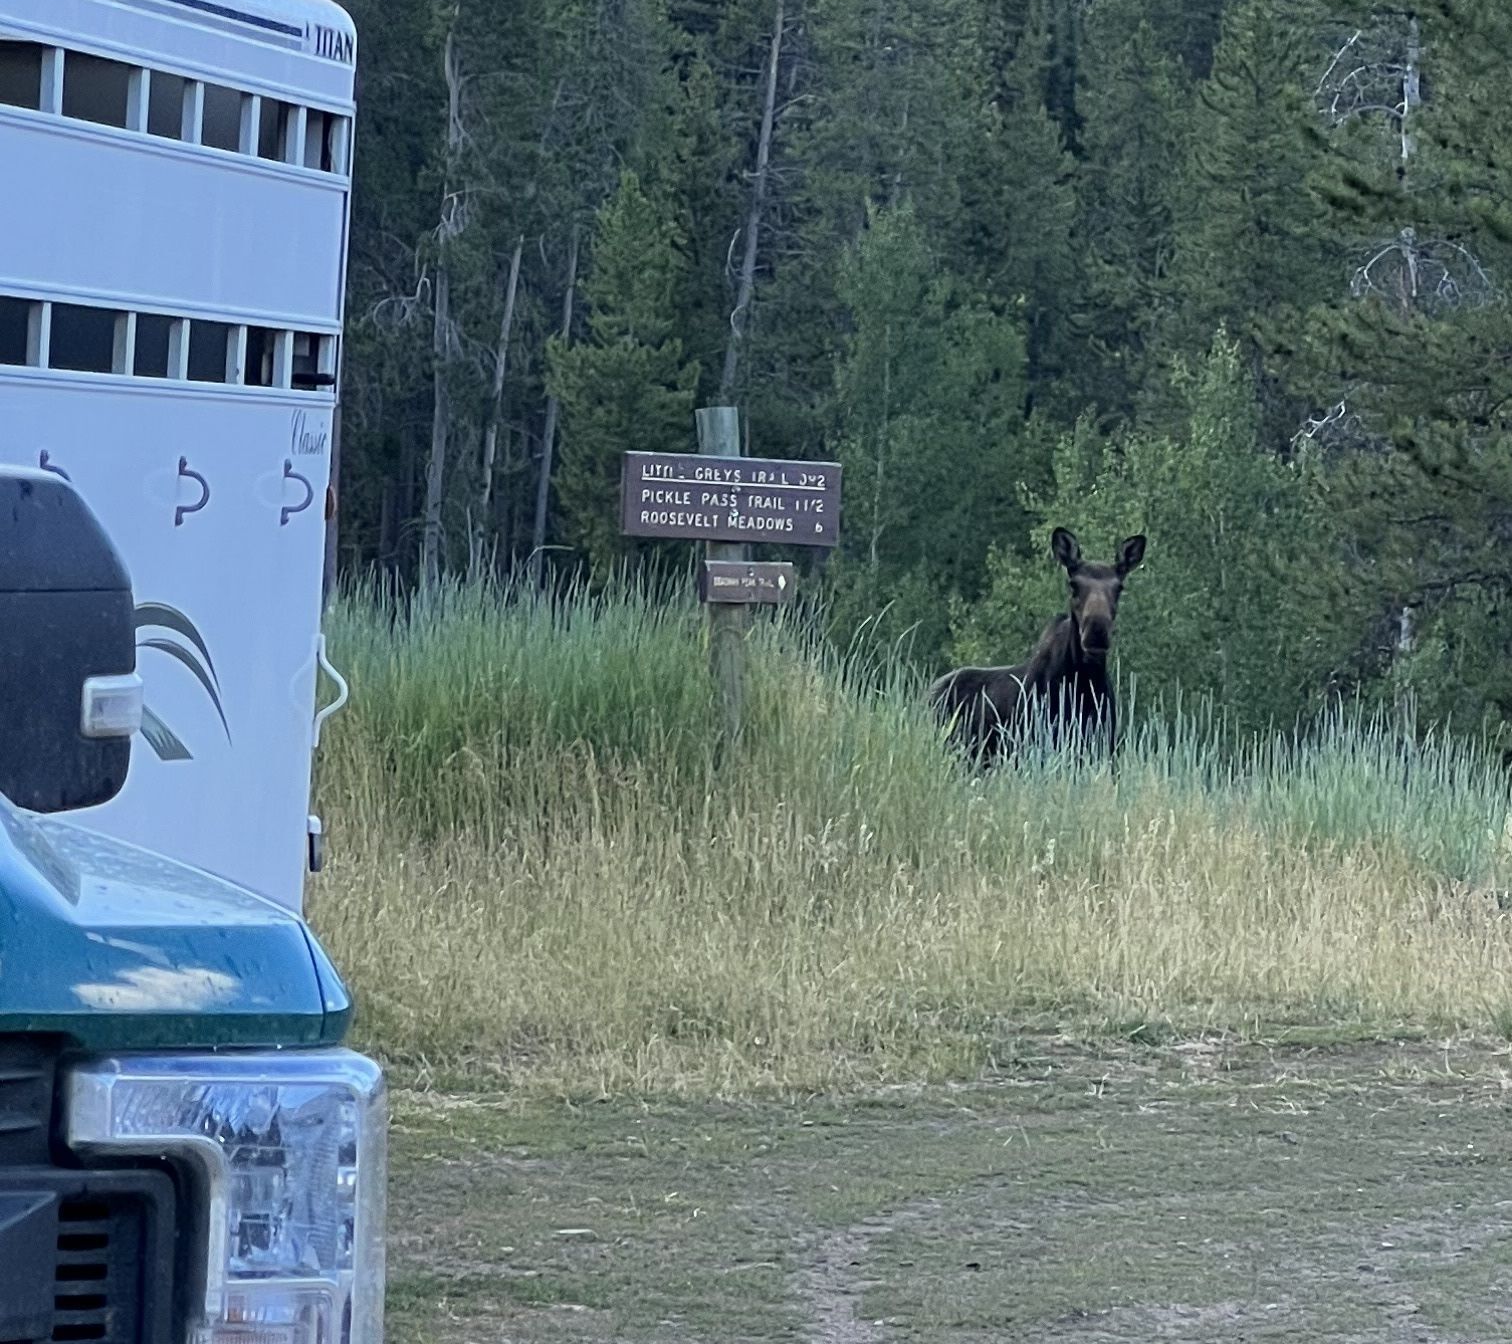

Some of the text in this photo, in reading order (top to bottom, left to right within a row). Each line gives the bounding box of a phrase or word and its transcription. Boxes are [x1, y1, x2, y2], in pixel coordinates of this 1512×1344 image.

[314, 24, 354, 65] TITAN
[642, 464, 686, 479] LITT
[695, 467, 741, 483] GREYS
[751, 470, 789, 485] TRL
[641, 489, 691, 505] PICKLE
[701, 492, 738, 507] PASS
[748, 495, 785, 510] TRAIL
[640, 510, 719, 528] ROOSEVELT
[727, 514, 794, 531] MEADOWS
